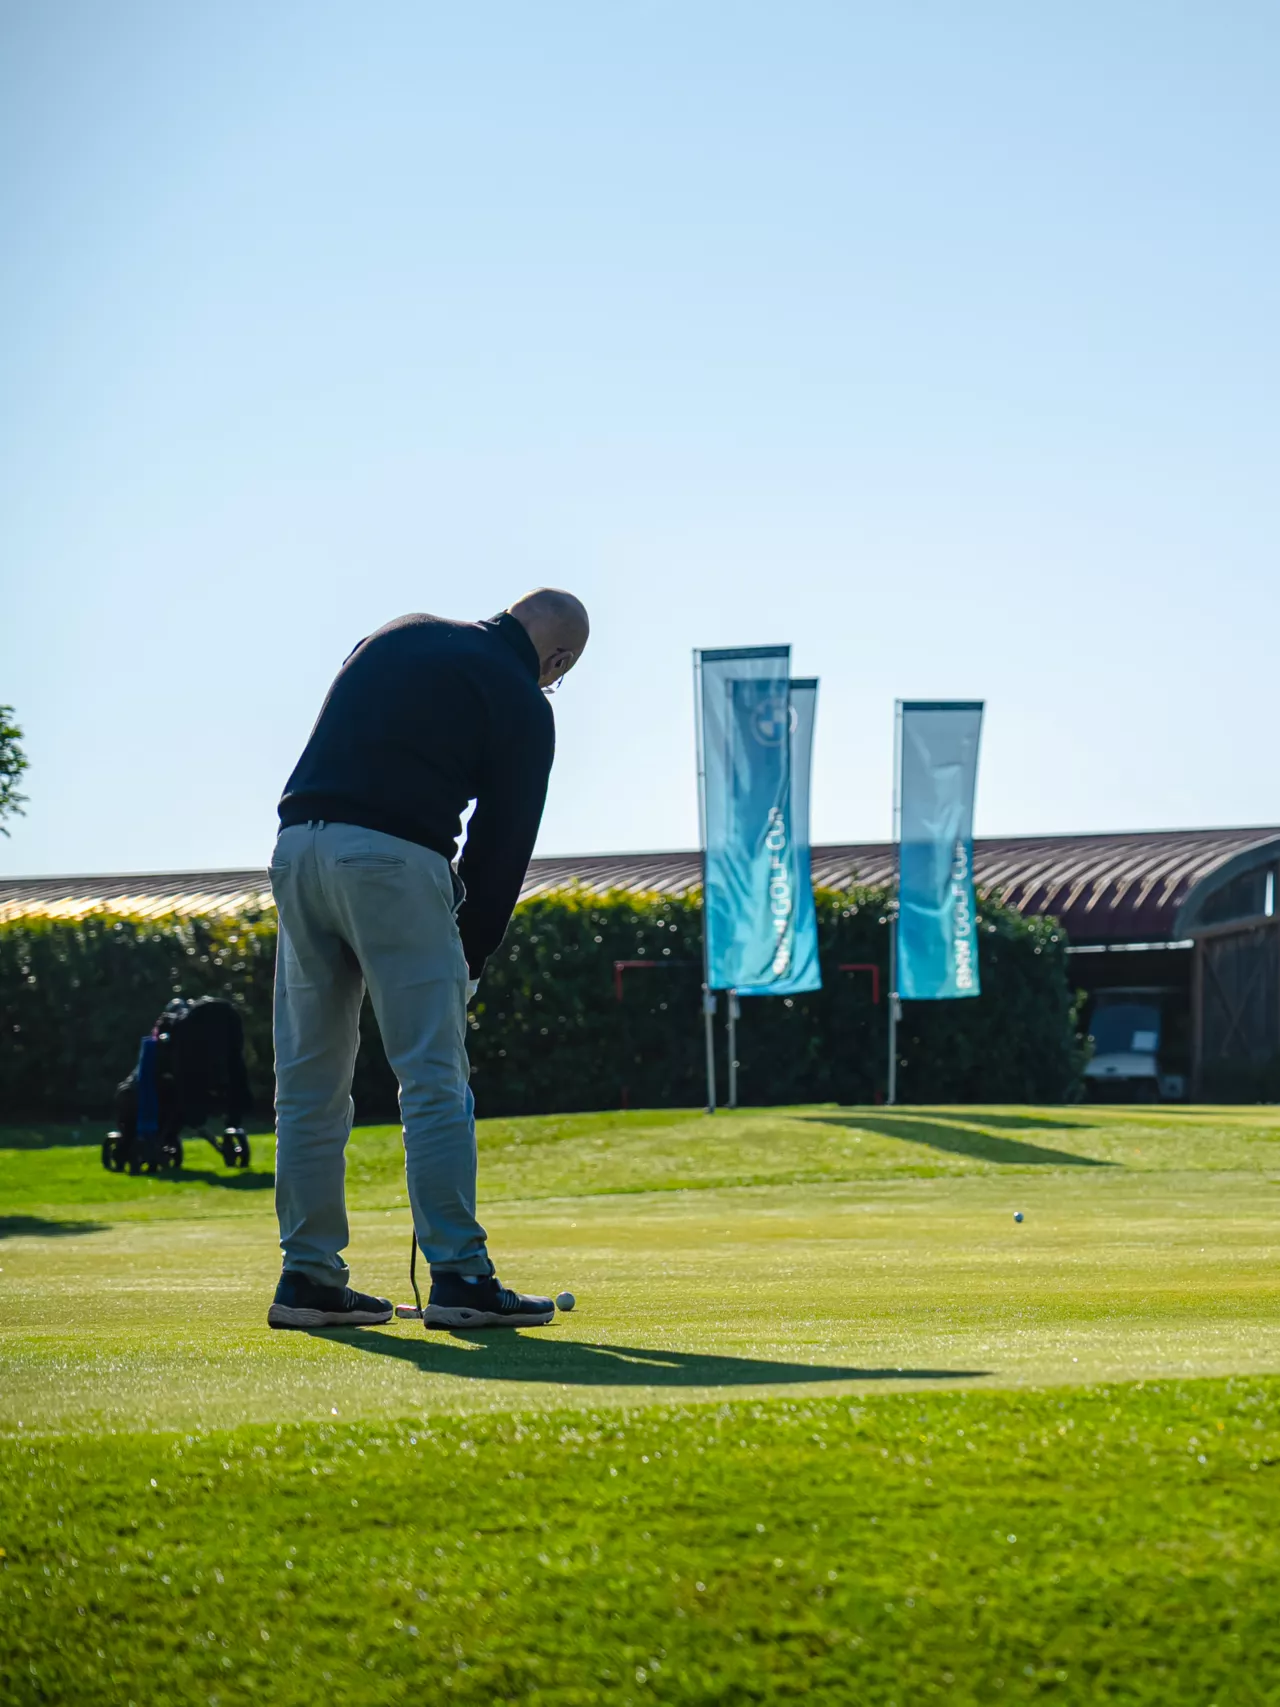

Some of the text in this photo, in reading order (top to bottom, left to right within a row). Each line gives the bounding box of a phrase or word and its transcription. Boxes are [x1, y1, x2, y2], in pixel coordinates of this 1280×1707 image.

[768, 855, 792, 917] GOLF
[951, 882, 971, 937] GOLF
[954, 940, 973, 990] BMW
